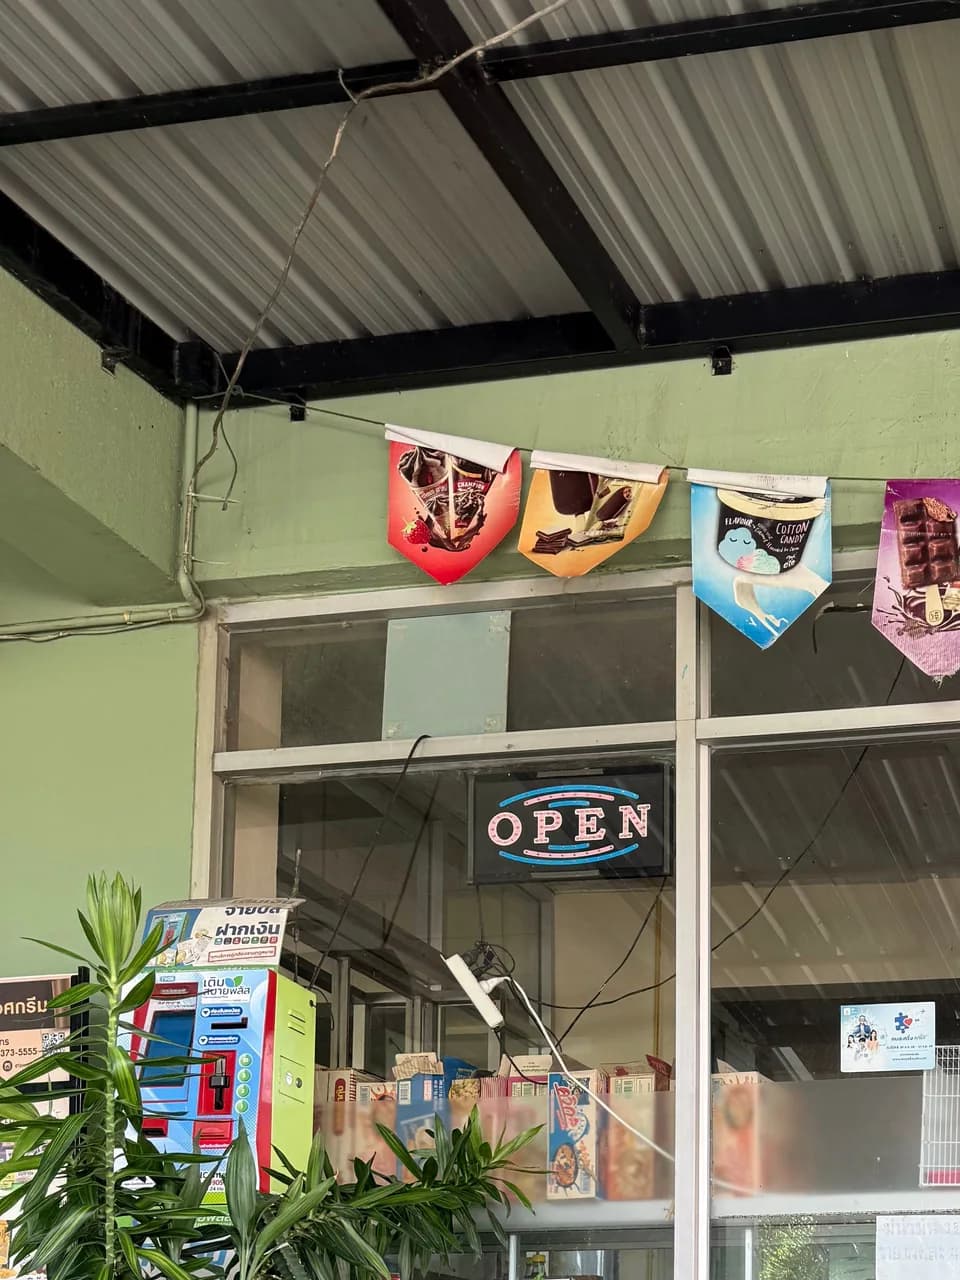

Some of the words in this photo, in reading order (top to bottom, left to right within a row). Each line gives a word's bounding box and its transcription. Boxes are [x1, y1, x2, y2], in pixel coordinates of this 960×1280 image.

[457, 481, 485, 491] CHAMPION
[776, 520, 810, 535] COTTON
[780, 533, 805, 545] CANDY
[487, 803, 651, 847] OPEN
[215, 921, 281, 937] ฝากเงิน
[203, 976, 225, 988] เติม
